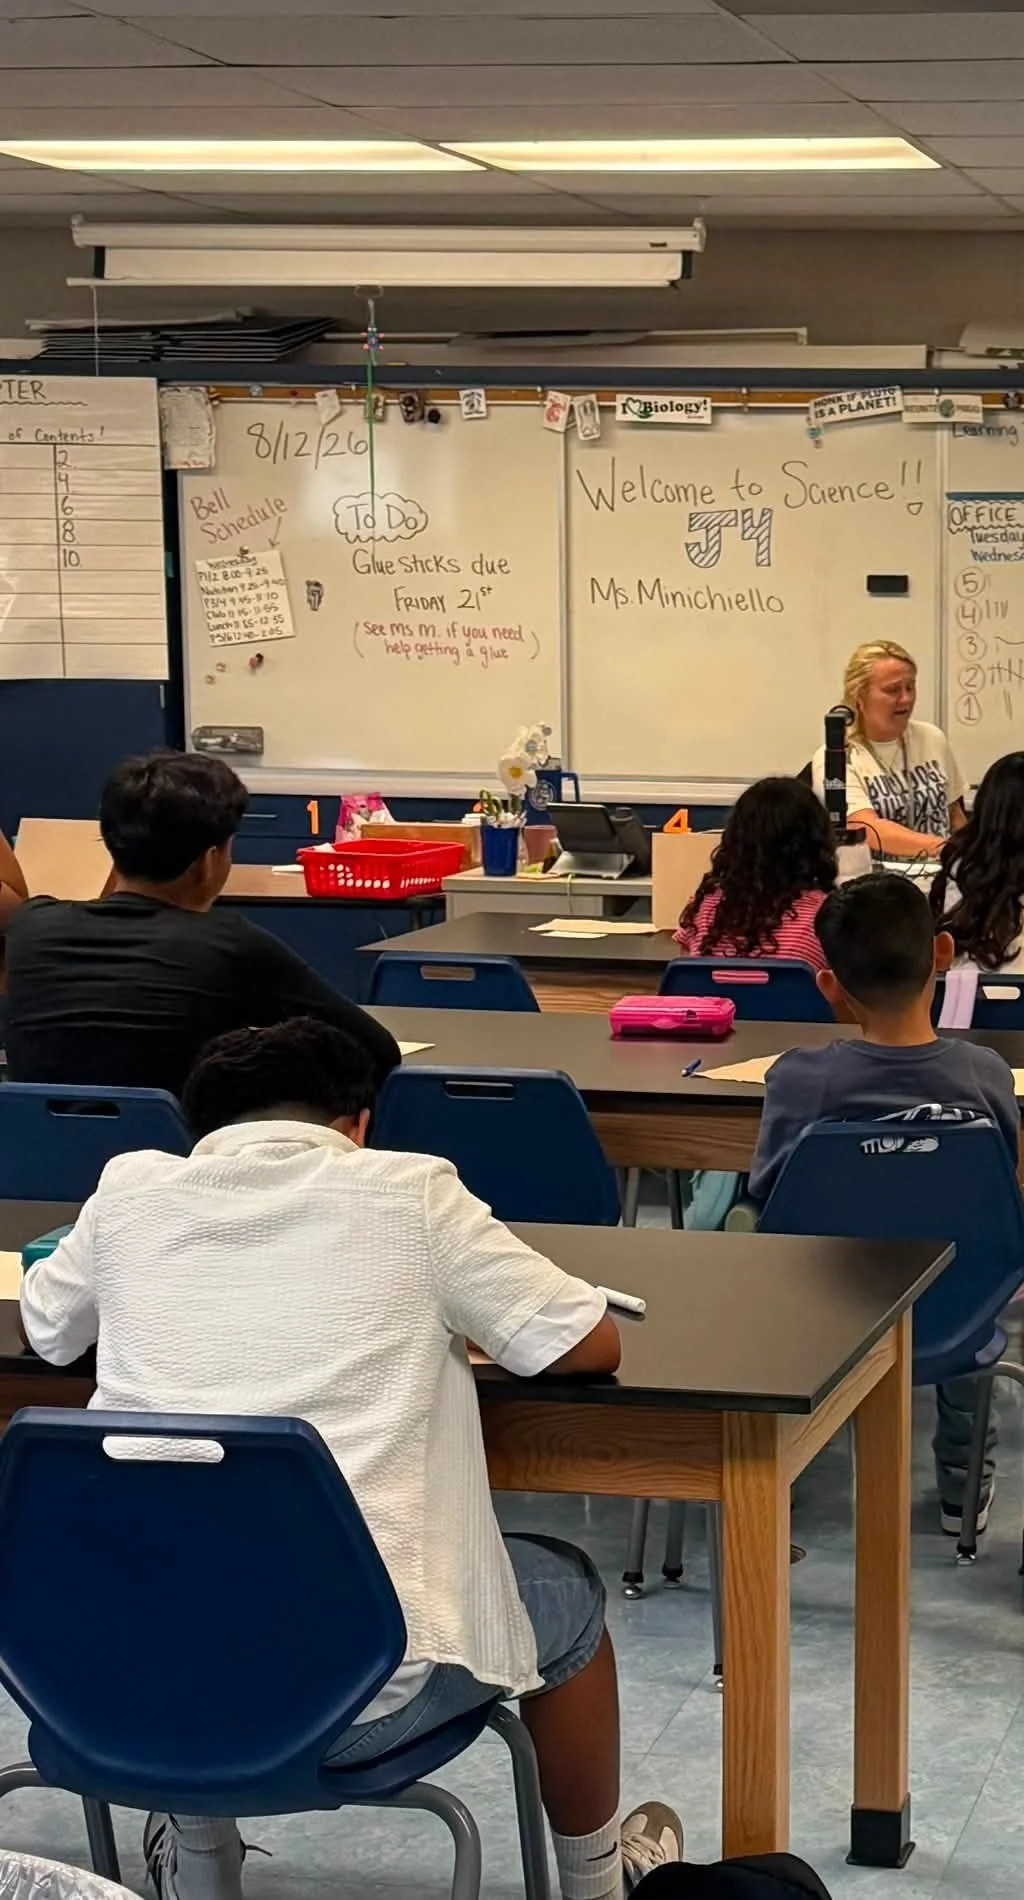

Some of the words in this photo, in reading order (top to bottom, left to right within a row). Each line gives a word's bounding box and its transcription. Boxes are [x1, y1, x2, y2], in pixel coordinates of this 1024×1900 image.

[0, 379, 47, 400] TER
[858, 387, 896, 400] PLUTO
[643, 399, 708, 414] Biology!
[815, 407, 825, 419] IS
[828, 406, 837, 416] A
[839, 396, 897, 414] PLANET!
[8, 427, 23, 442] of
[247, 420, 369, 471] 8/12/26
[953, 423, 1018, 447] Learning
[576, 456, 716, 512] Welcome
[730, 467, 764, 502] to
[782, 459, 923, 516] Science!!
[190, 487, 231, 521] Bell
[346, 503, 376, 531] To
[386, 503, 419, 530] Do
[950, 504, 1017, 526] OFFICE
[200, 497, 288, 545] Schedule
[685, 507, 773, 569] J4
[471, 552, 512, 576] due
[394, 586, 446, 613] FRIDAY
[591, 577, 633, 610] Ms.
[637, 577, 784, 613] Minichiello
[447, 621, 459, 639] if
[462, 625, 488, 648] you
[491, 625, 525, 643] need
[384, 639, 412, 661] help
[415, 641, 460, 666] getting
[306, 799, 319, 835] 1
[663, 808, 692, 834] 4
